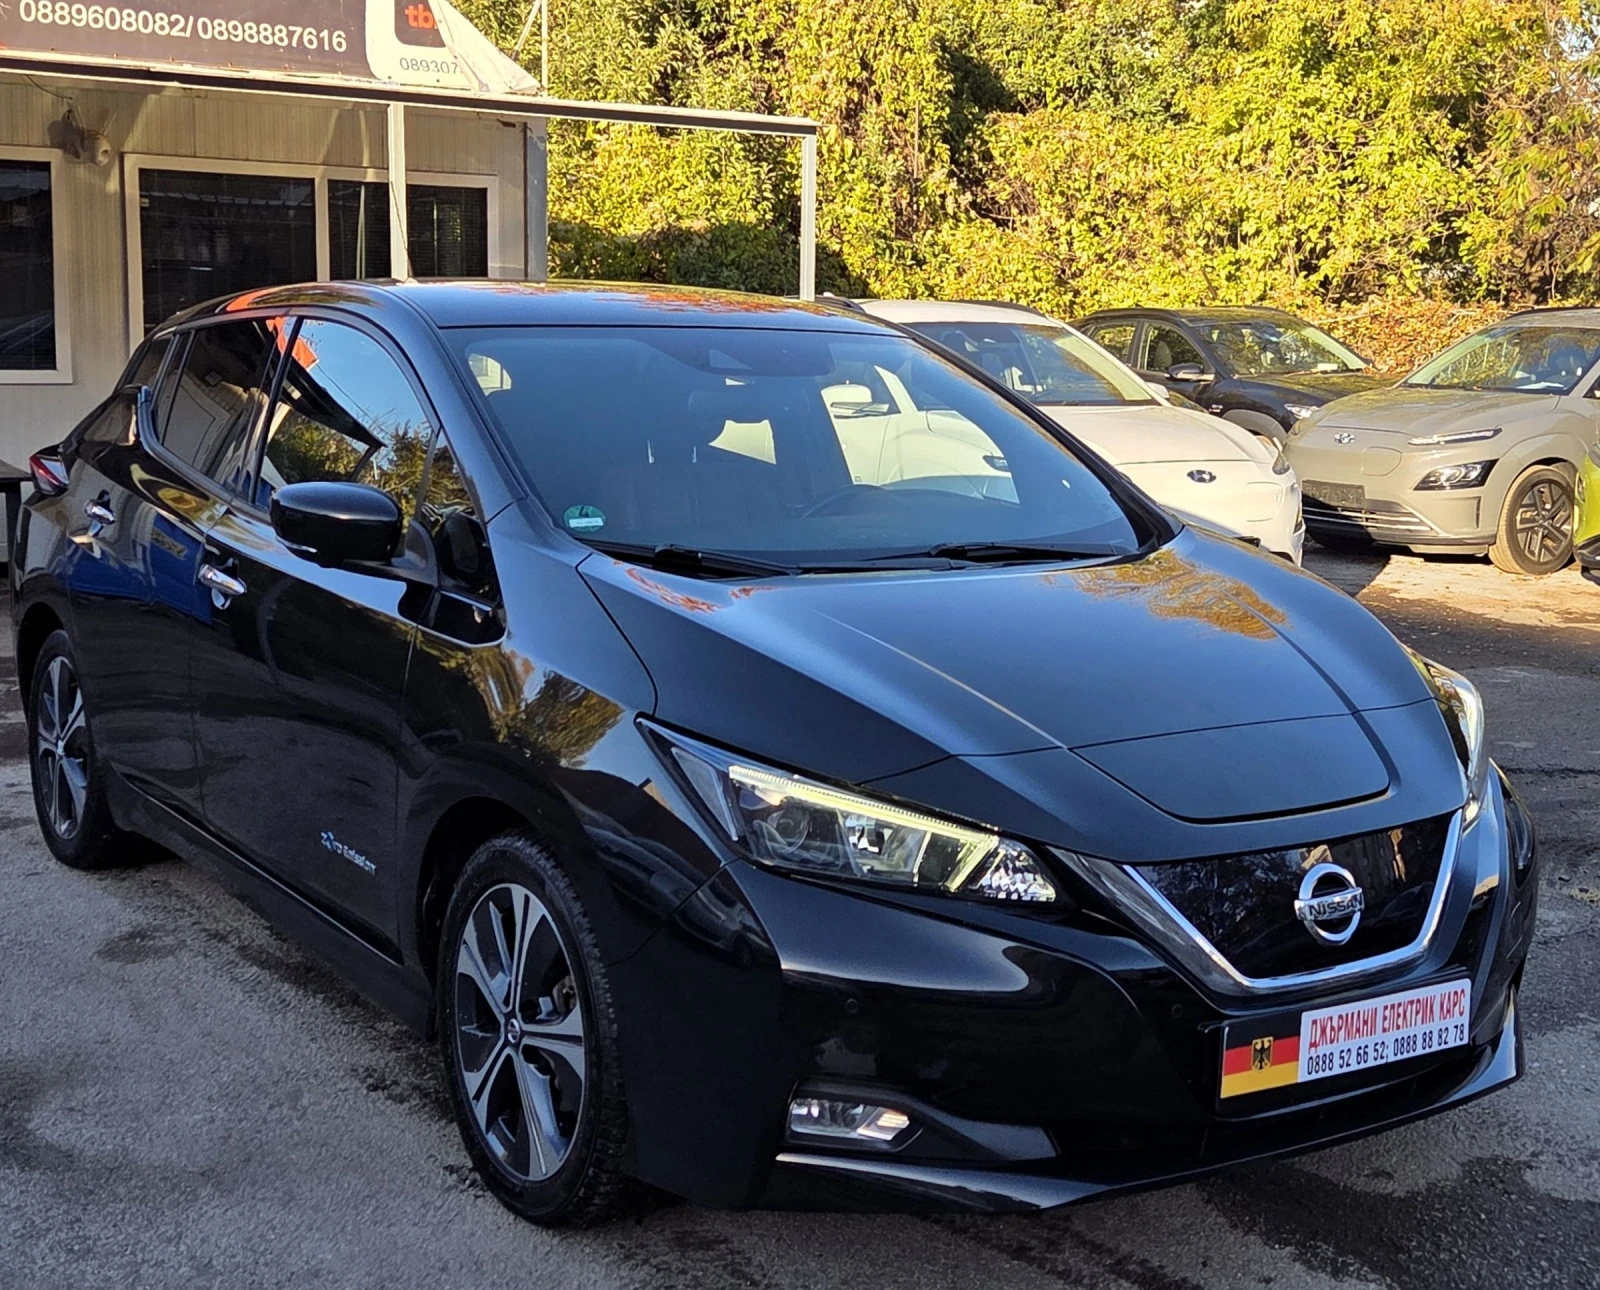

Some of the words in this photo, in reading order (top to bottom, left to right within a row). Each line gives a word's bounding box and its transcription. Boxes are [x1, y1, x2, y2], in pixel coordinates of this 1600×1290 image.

[1309, 893, 1362, 917] NISSAN
[1308, 1007, 1378, 1055] ДЖЪРМАНИ
[1382, 994, 1436, 1034] ЕЛЕКТРИК
[1439, 988, 1466, 1021] КАРС
[1307, 1051, 1334, 1075] 0888
[1339, 1048, 1352, 1069] 52
[1356, 1044, 1369, 1065] 66
[1373, 1041, 1389, 1063] 52;
[1393, 1034, 1418, 1057] 0888
[1422, 1030, 1433, 1050] 88
[1438, 1026, 1449, 1047] 82
[1453, 1023, 1465, 1042] 78
